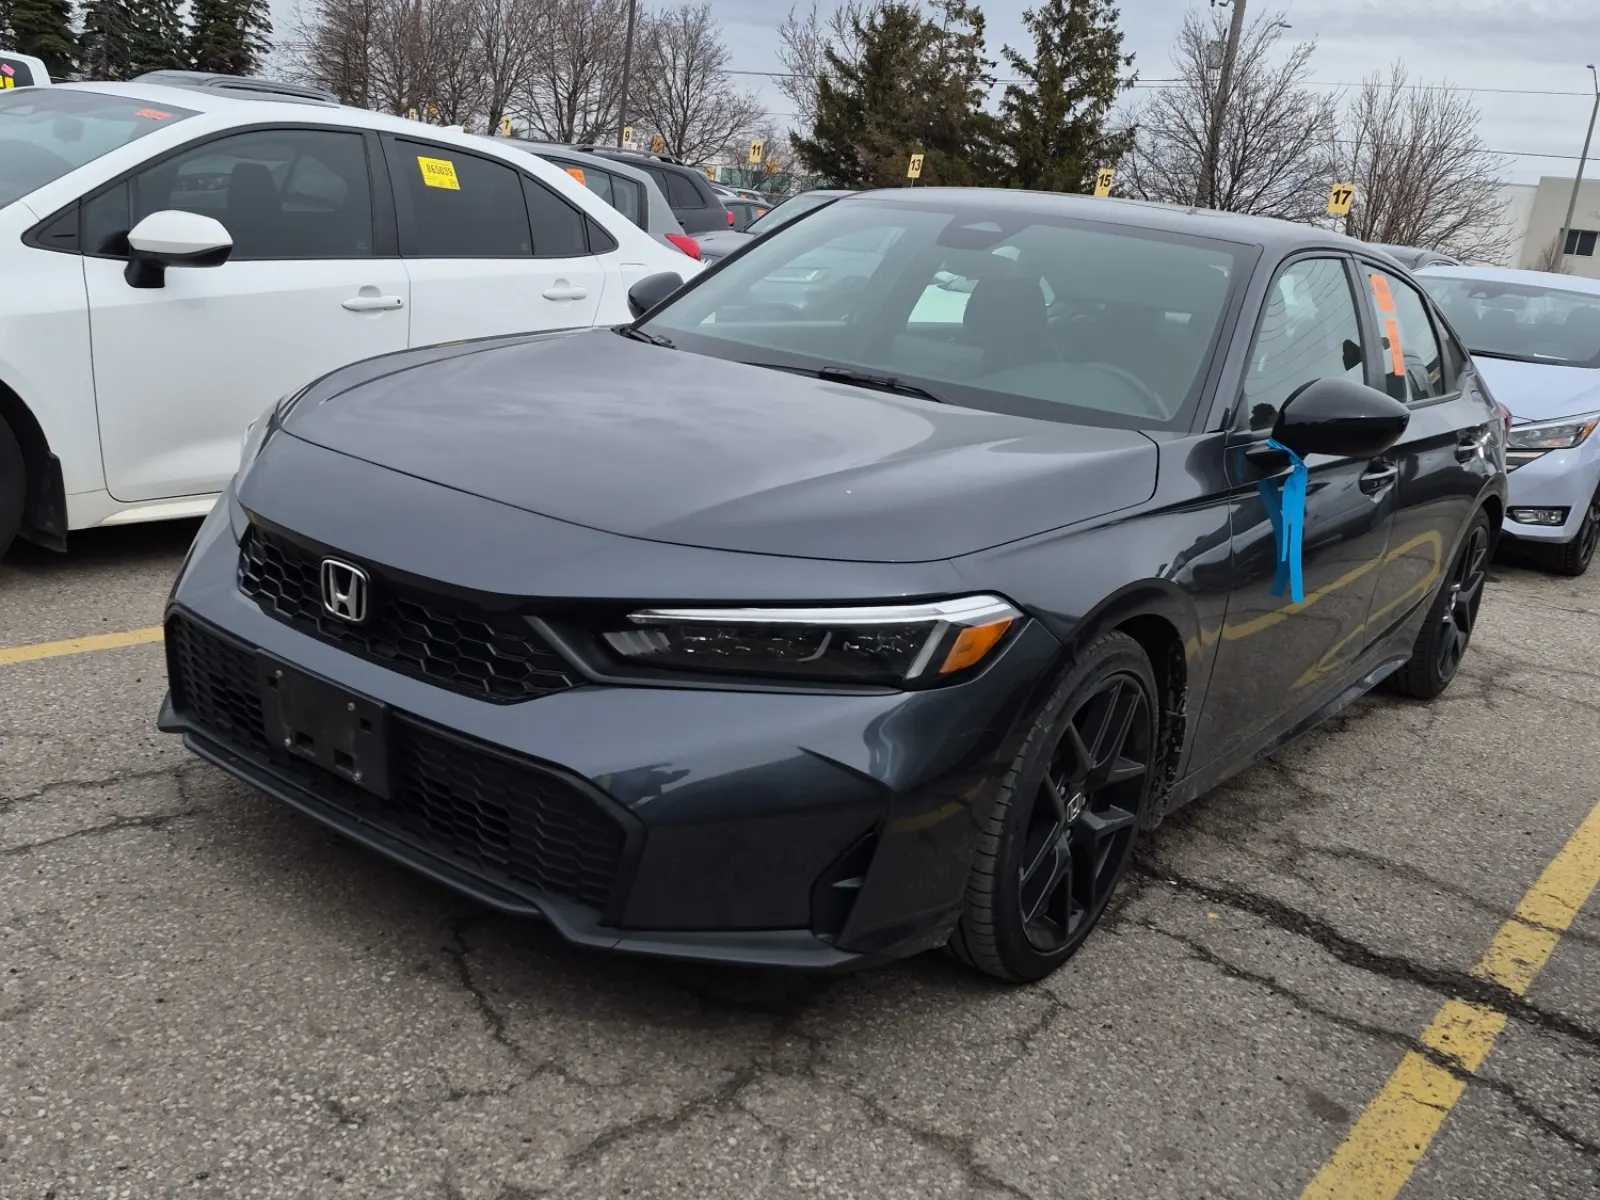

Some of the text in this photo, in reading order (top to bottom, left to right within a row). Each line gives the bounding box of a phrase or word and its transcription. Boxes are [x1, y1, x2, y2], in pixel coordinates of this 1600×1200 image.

[504, 119, 510, 130] 7
[624, 130, 630, 141] 9
[751, 144, 761, 156] 11
[426, 163, 453, 177] 865039
[911, 158, 921, 171] 13
[1099, 173, 1112, 188] 15
[1333, 189, 1352, 205] 17
